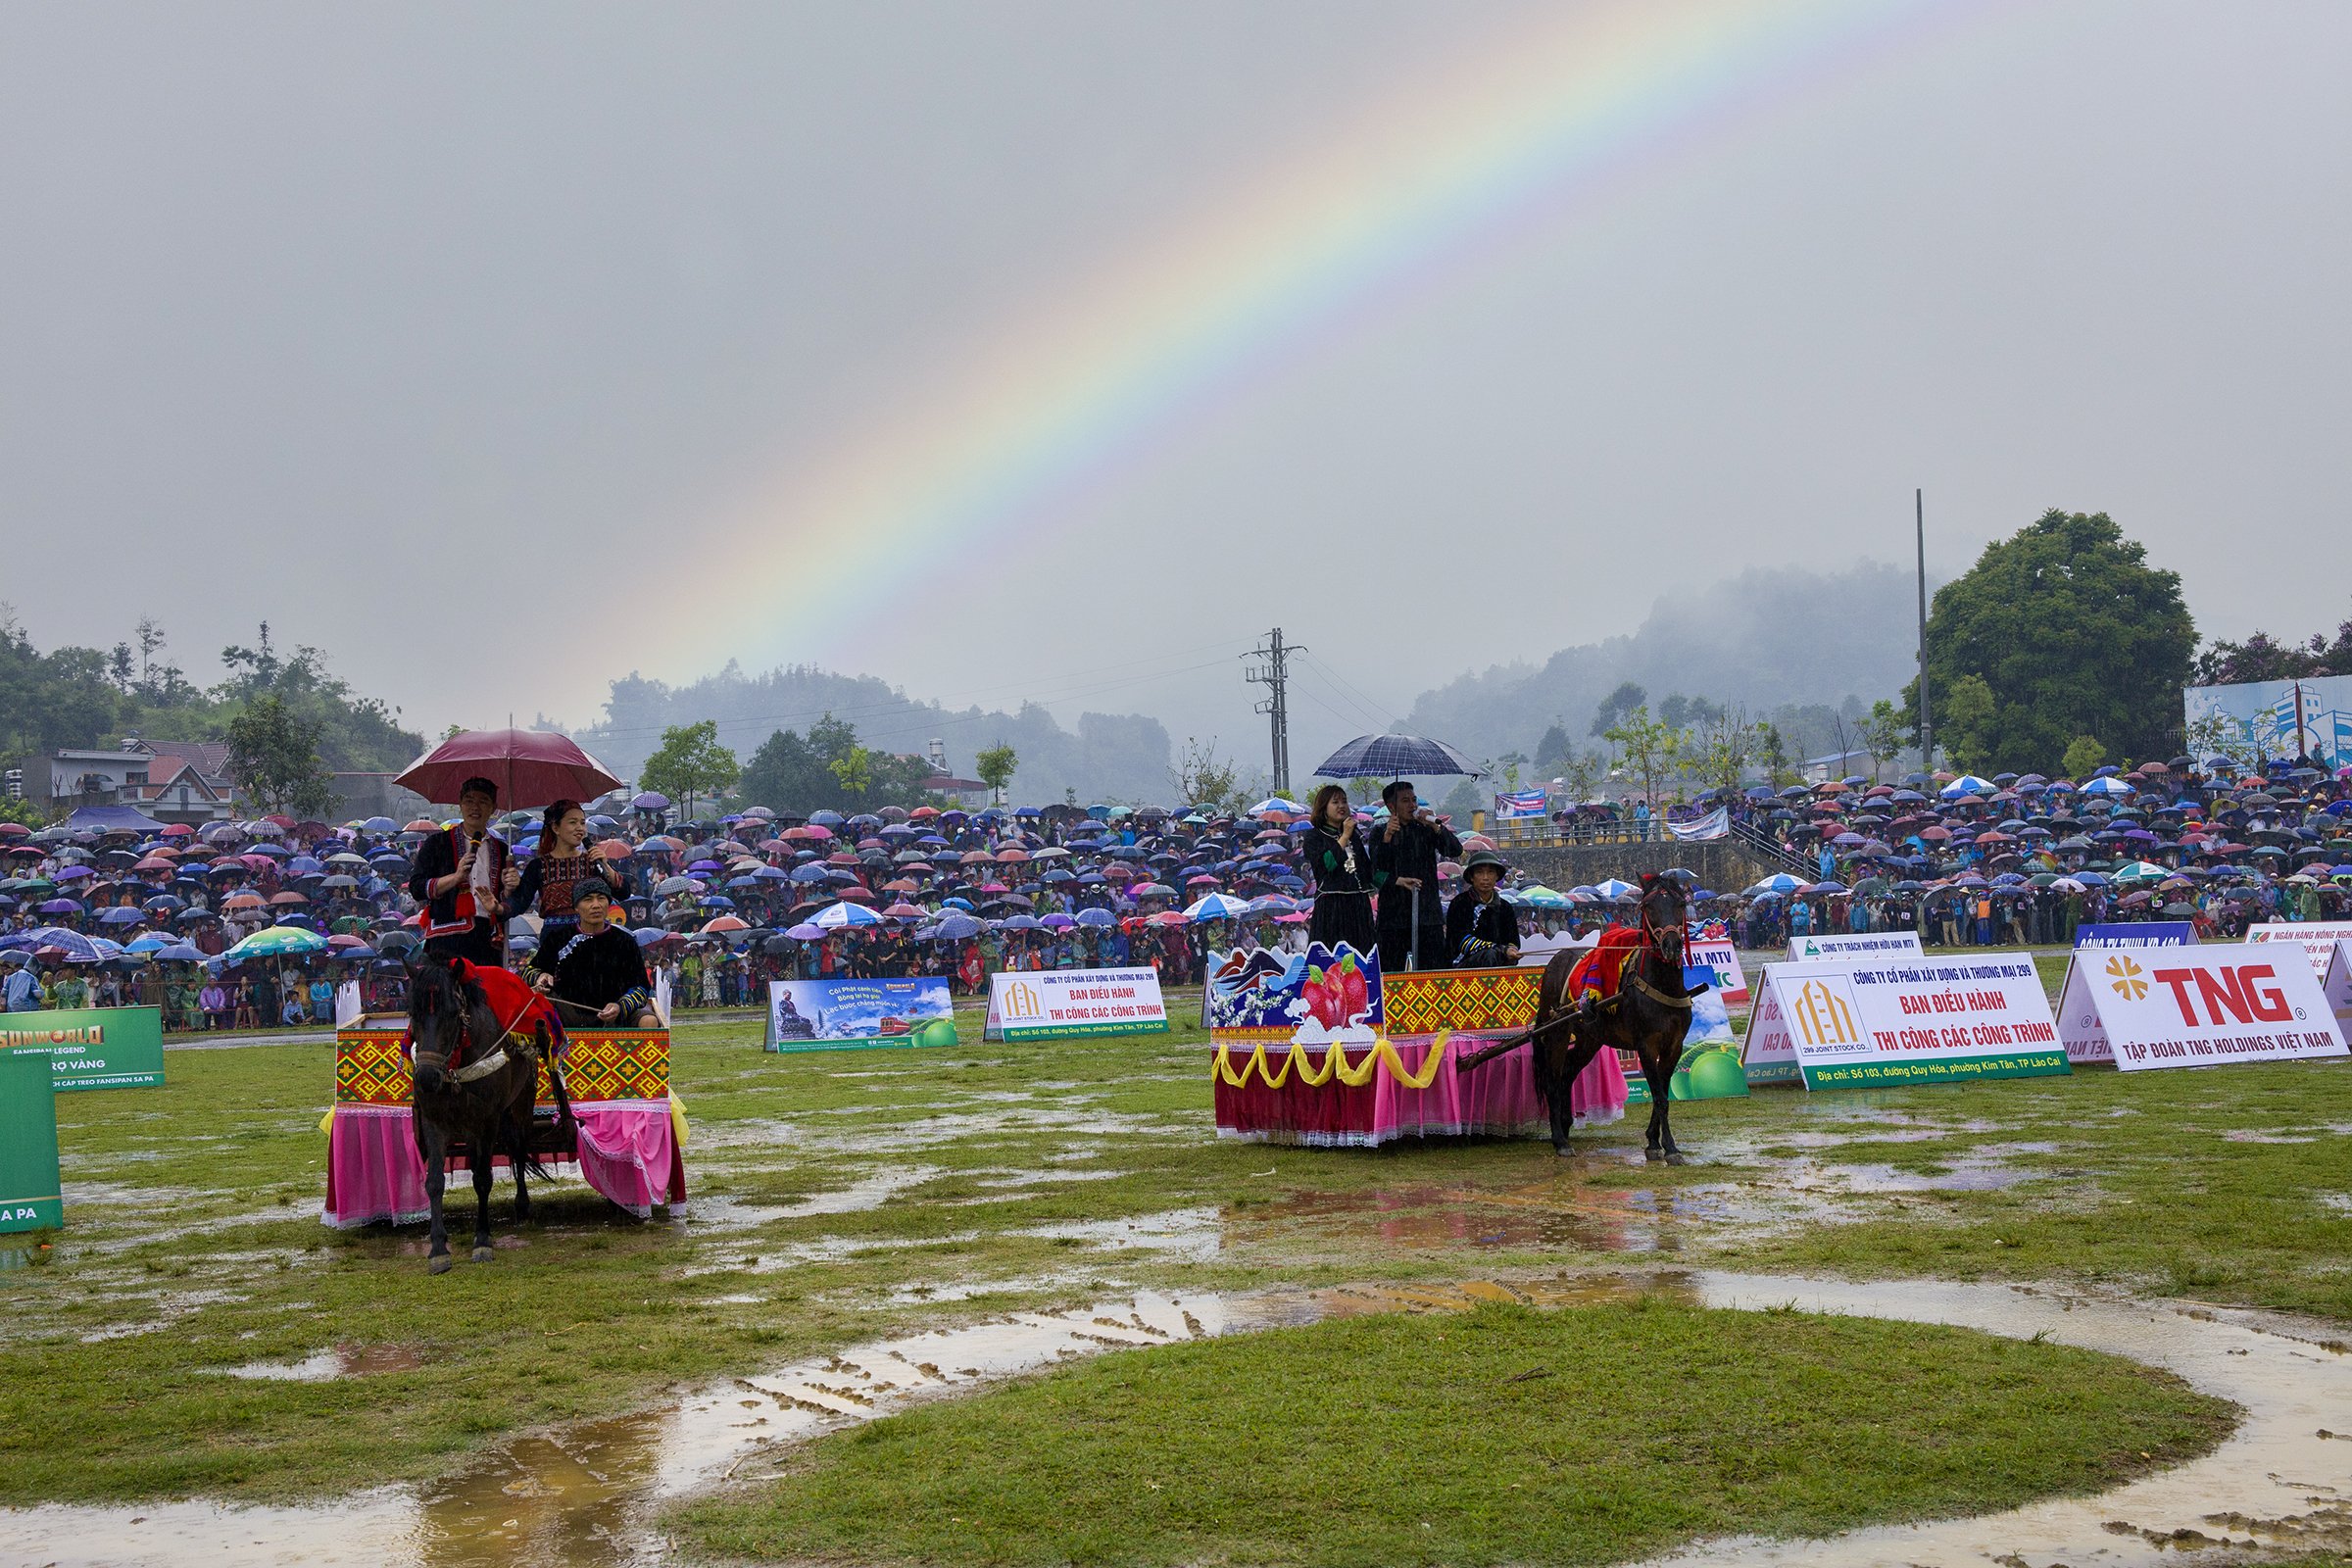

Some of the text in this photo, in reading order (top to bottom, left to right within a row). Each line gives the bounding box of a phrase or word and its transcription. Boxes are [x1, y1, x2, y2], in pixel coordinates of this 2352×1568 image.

[1821, 942, 1837, 953] CÔNG
[1837, 943, 1844, 952] TY
[1844, 941, 1862, 952] TRÁCH
[1862, 939, 1880, 953] NHIỆM
[1890, 940, 1902, 951] HẠN
[1903, 939, 1915, 949] MTV
[1705, 951, 1732, 964] MTV
[1043, 974, 1056, 984] CÔNG
[1853, 964, 2032, 985] CÔNG TY CỔ PHẦN XÂY DỰNG VÀ THƯƠNG MẠI 299
[1069, 985, 1135, 1001] BAN ĐIỀU HÀNH
[2153, 964, 2293, 1027] TNG
[1899, 988, 2007, 1015] BAN ĐIỀU HÀNH
[1050, 1002, 1162, 1021] THI CÔNG CÁC CÔNG TRÌNH
[1874, 1019, 2055, 1052] THI CÔNG CÁC CÔNG TRÌNH
[54, 1046, 86, 1054] LEGEND
[2123, 1031, 2334, 1063] TẬP ĐOÀN TNG HOLDINGS VIỆT NAM
[70, 1058, 106, 1070] VÀNG
[1817, 1071, 1832, 1082] Địa
[1834, 1068, 1850, 1080] chỉ:
[1852, 1068, 1864, 1078] Số
[1864, 1068, 1883, 1078] 103,
[1884, 1066, 1911, 1077] đường
[1911, 1065, 1929, 1076] Quy
[1950, 1062, 1982, 1074] phường
[1982, 1060, 1999, 1070] Kim
[1999, 1059, 2019, 1070] Tân,
[2017, 1058, 2029, 1068] TP
[2031, 1057, 2046, 1067] Lào
[2046, 1056, 2062, 1066] Cai
[96, 1076, 133, 1085] FANSIPAN
[16, 1207, 37, 1220] PA
